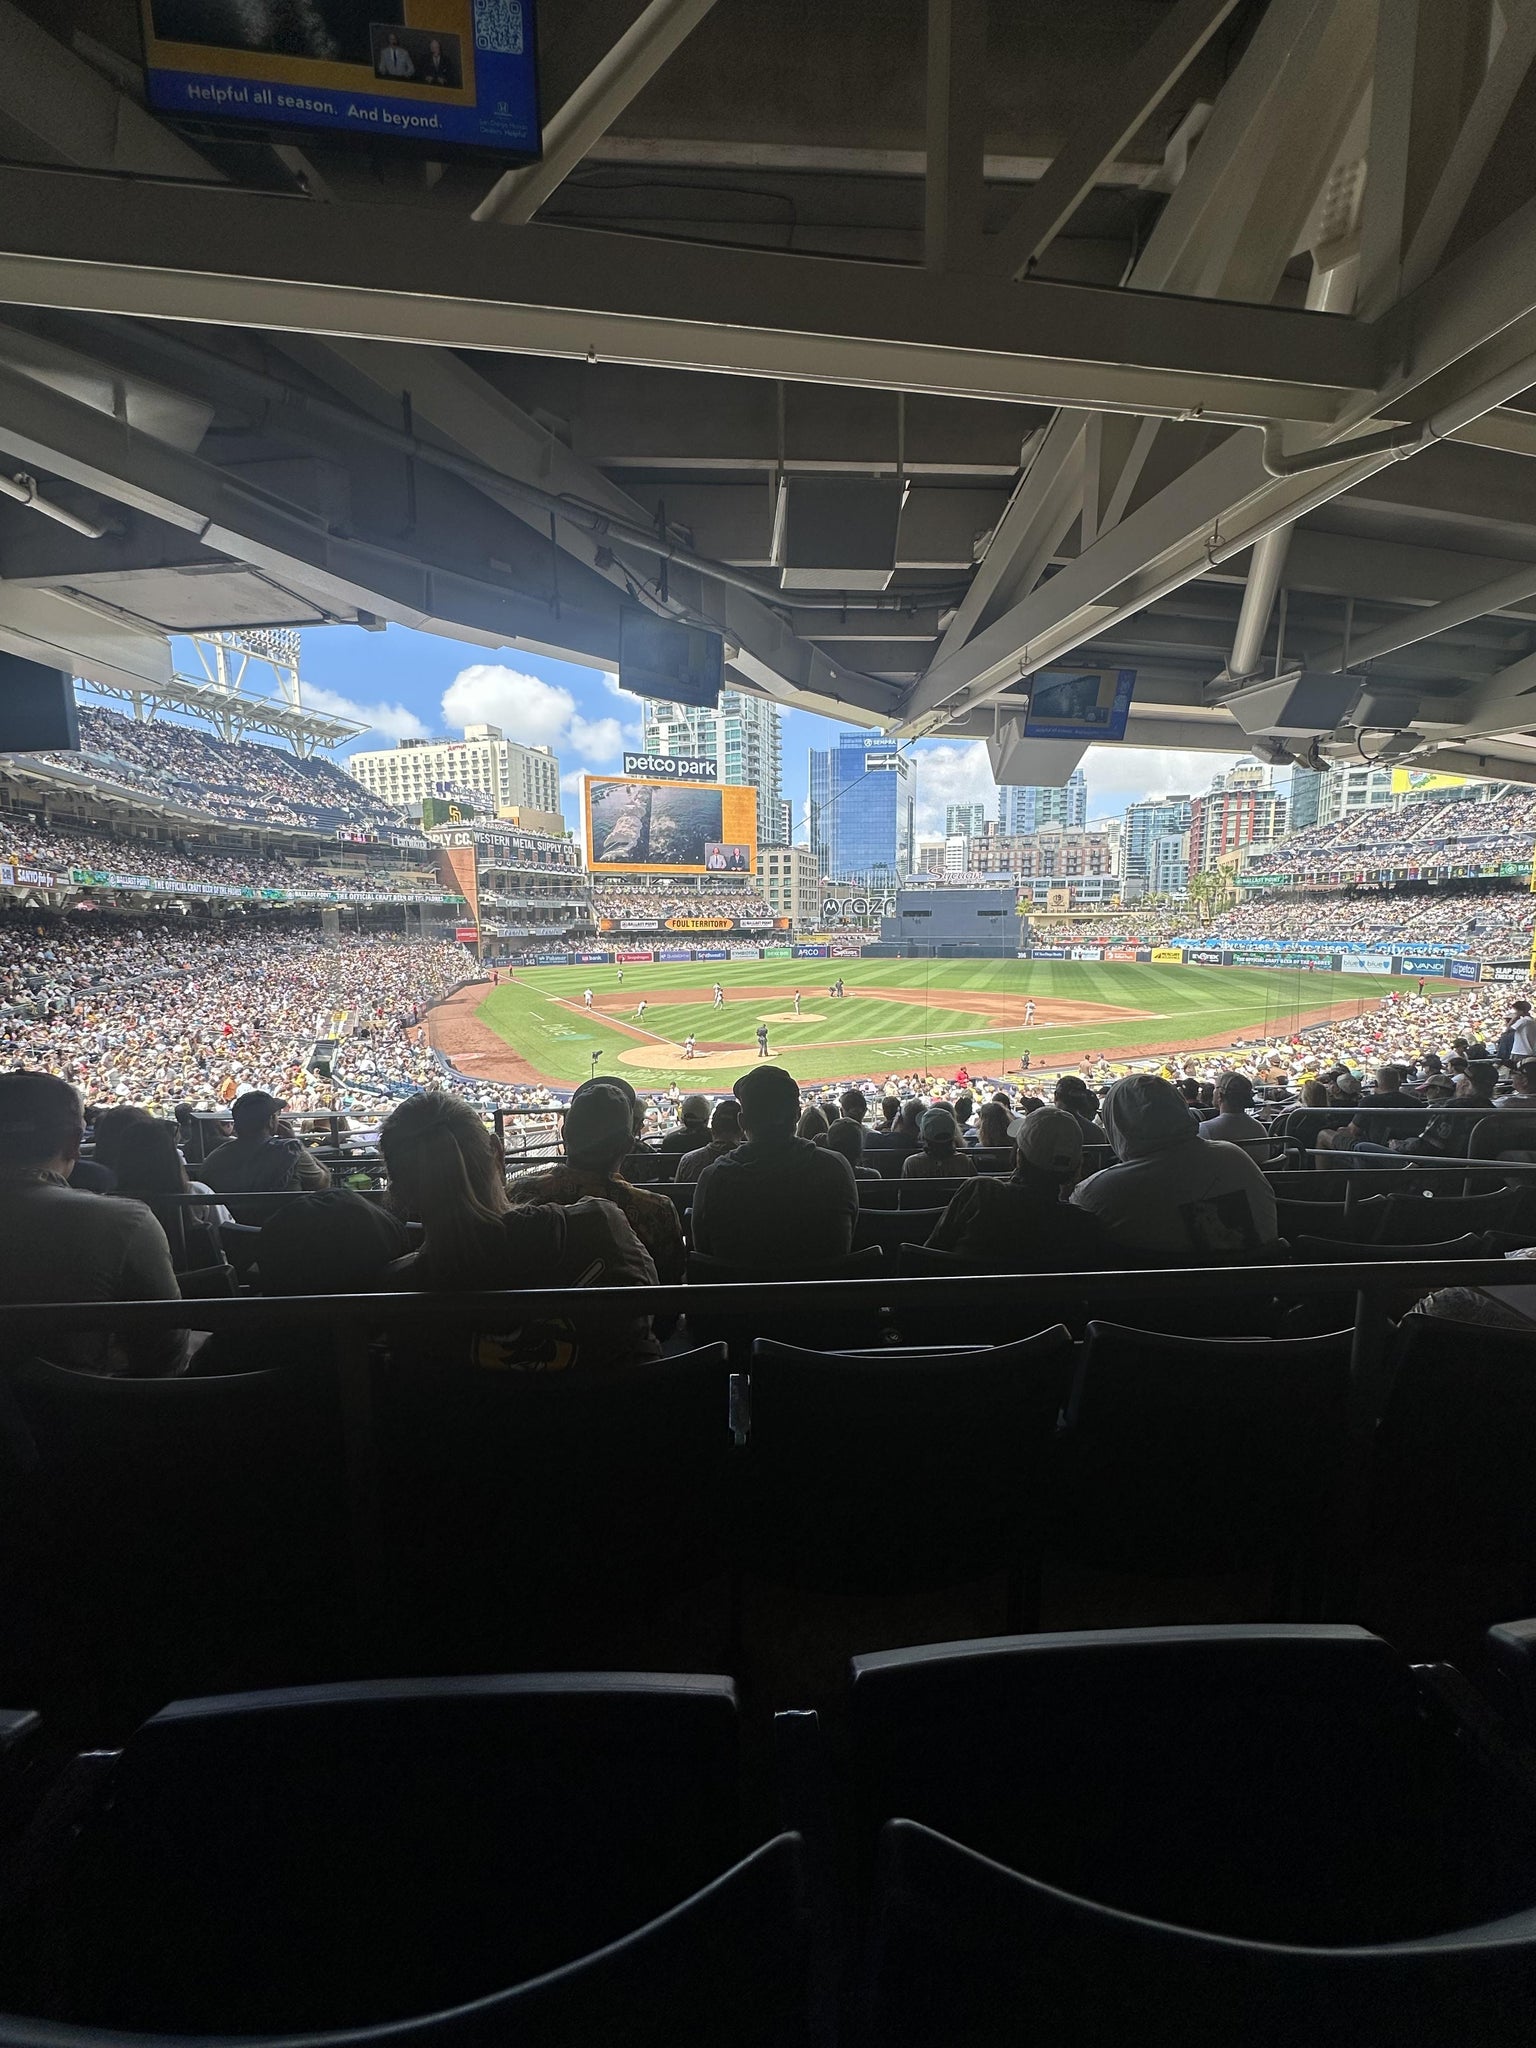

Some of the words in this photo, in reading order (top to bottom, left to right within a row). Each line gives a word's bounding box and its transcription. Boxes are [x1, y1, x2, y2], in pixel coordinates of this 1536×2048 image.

[188, 84, 248, 104] Helpful
[254, 89, 272, 104] all
[277, 92, 338, 115] season.
[348, 104, 378, 121] And
[383, 106, 443, 129] beyond.
[625, 755, 676, 772] petco
[678, 760, 716, 776] park
[473, 832, 510, 847] WESTERN
[512, 837, 536, 850] METAL
[537, 841, 562, 853] SUPPLY
[563, 844, 575, 854] CO.
[928, 865, 984, 884] Sycuan
[155, 880, 165, 889] THE
[166, 881, 187, 891] OFFICIAL
[842, 898, 895, 915] razr
[672, 920, 689, 928] FOUL
[691, 920, 728, 928] TERRITORY
[1459, 965, 1475, 974] petco
[872, 1044, 968, 1057] blue
